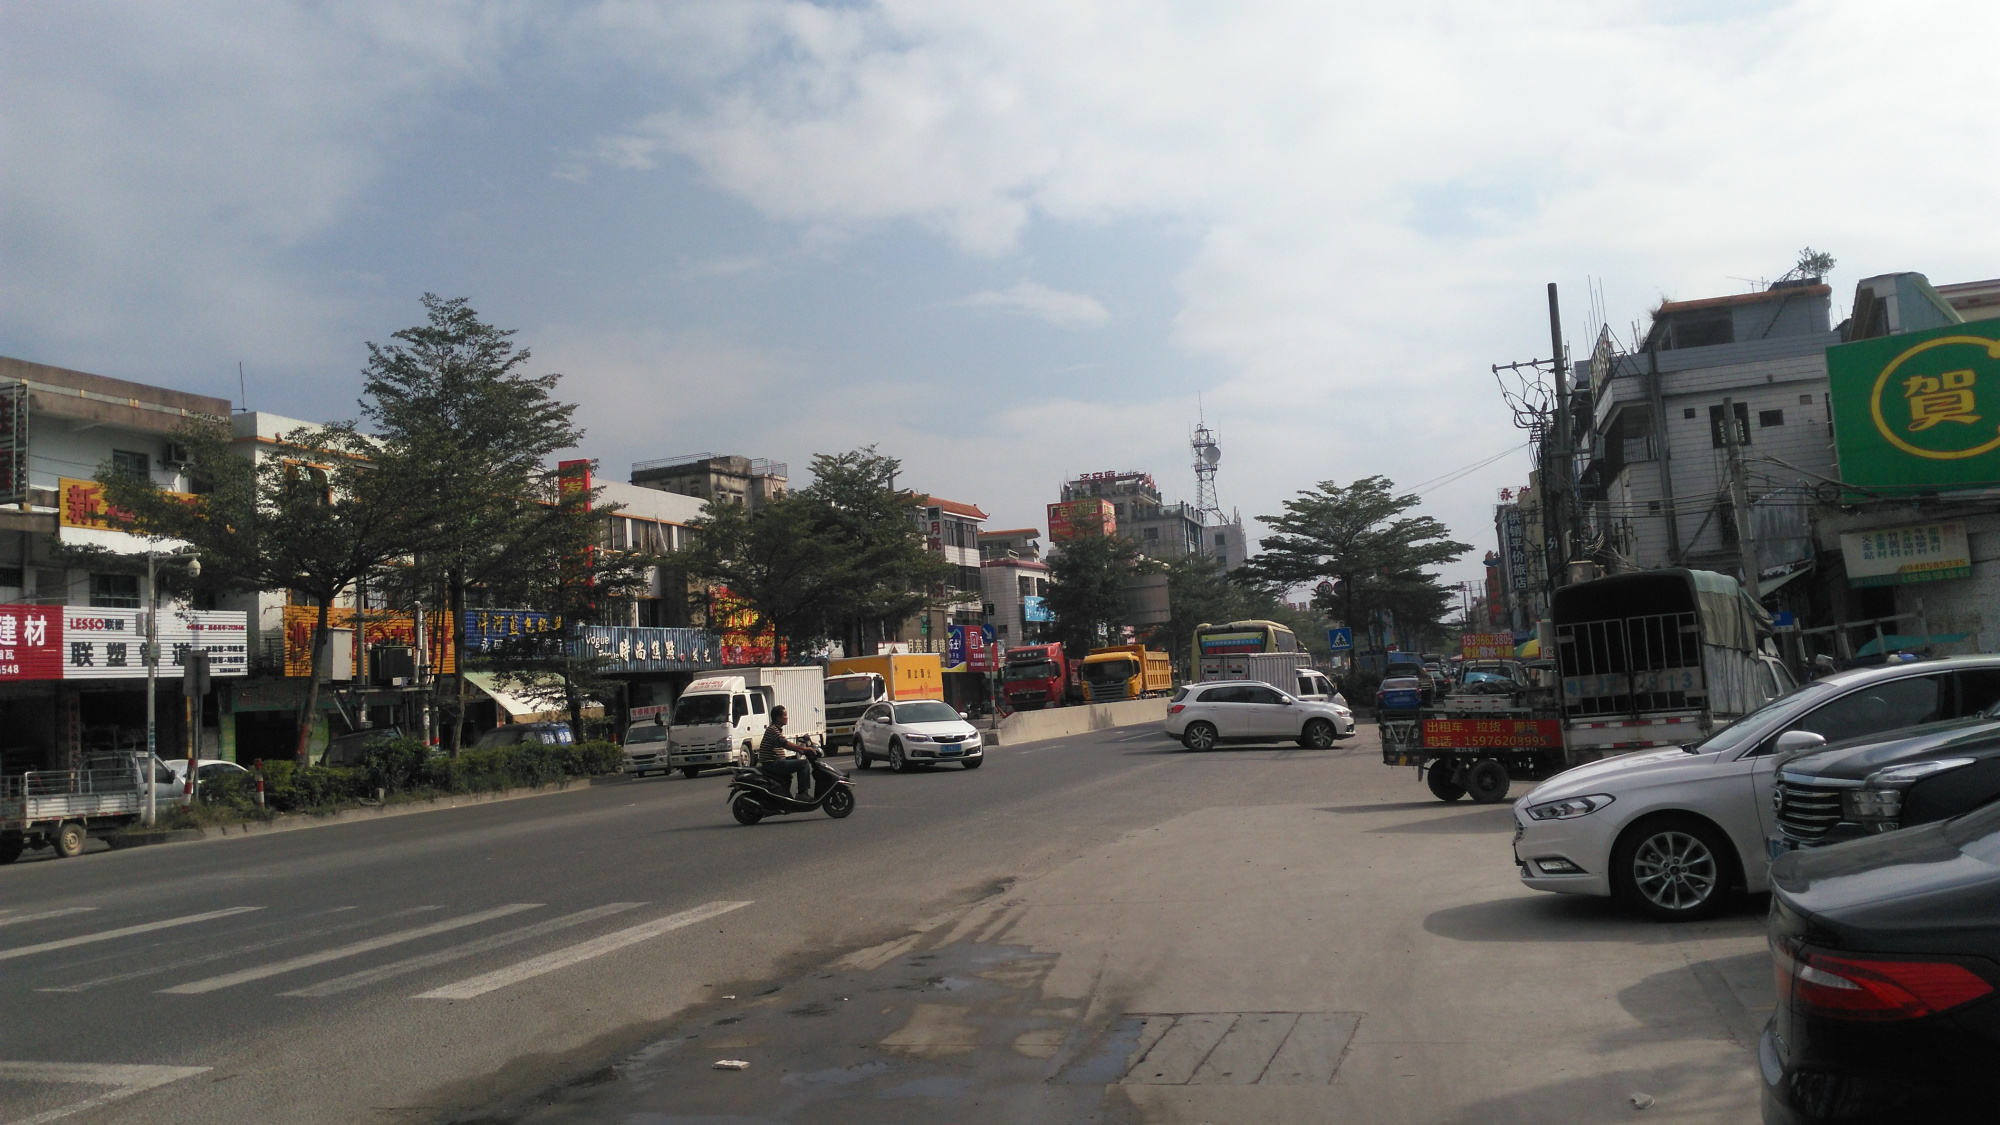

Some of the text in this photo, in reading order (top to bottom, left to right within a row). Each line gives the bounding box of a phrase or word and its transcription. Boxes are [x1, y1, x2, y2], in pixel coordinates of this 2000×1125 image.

[1901, 369, 1982, 432] 賀
[1508, 512, 1527, 589] 供销平价旅店
[0, 614, 47, 646] 建材
[585, 634, 610, 649] Vogue
[1463, 634, 1513, 646] 15396623805
[0, 665, 19, 675] 548
